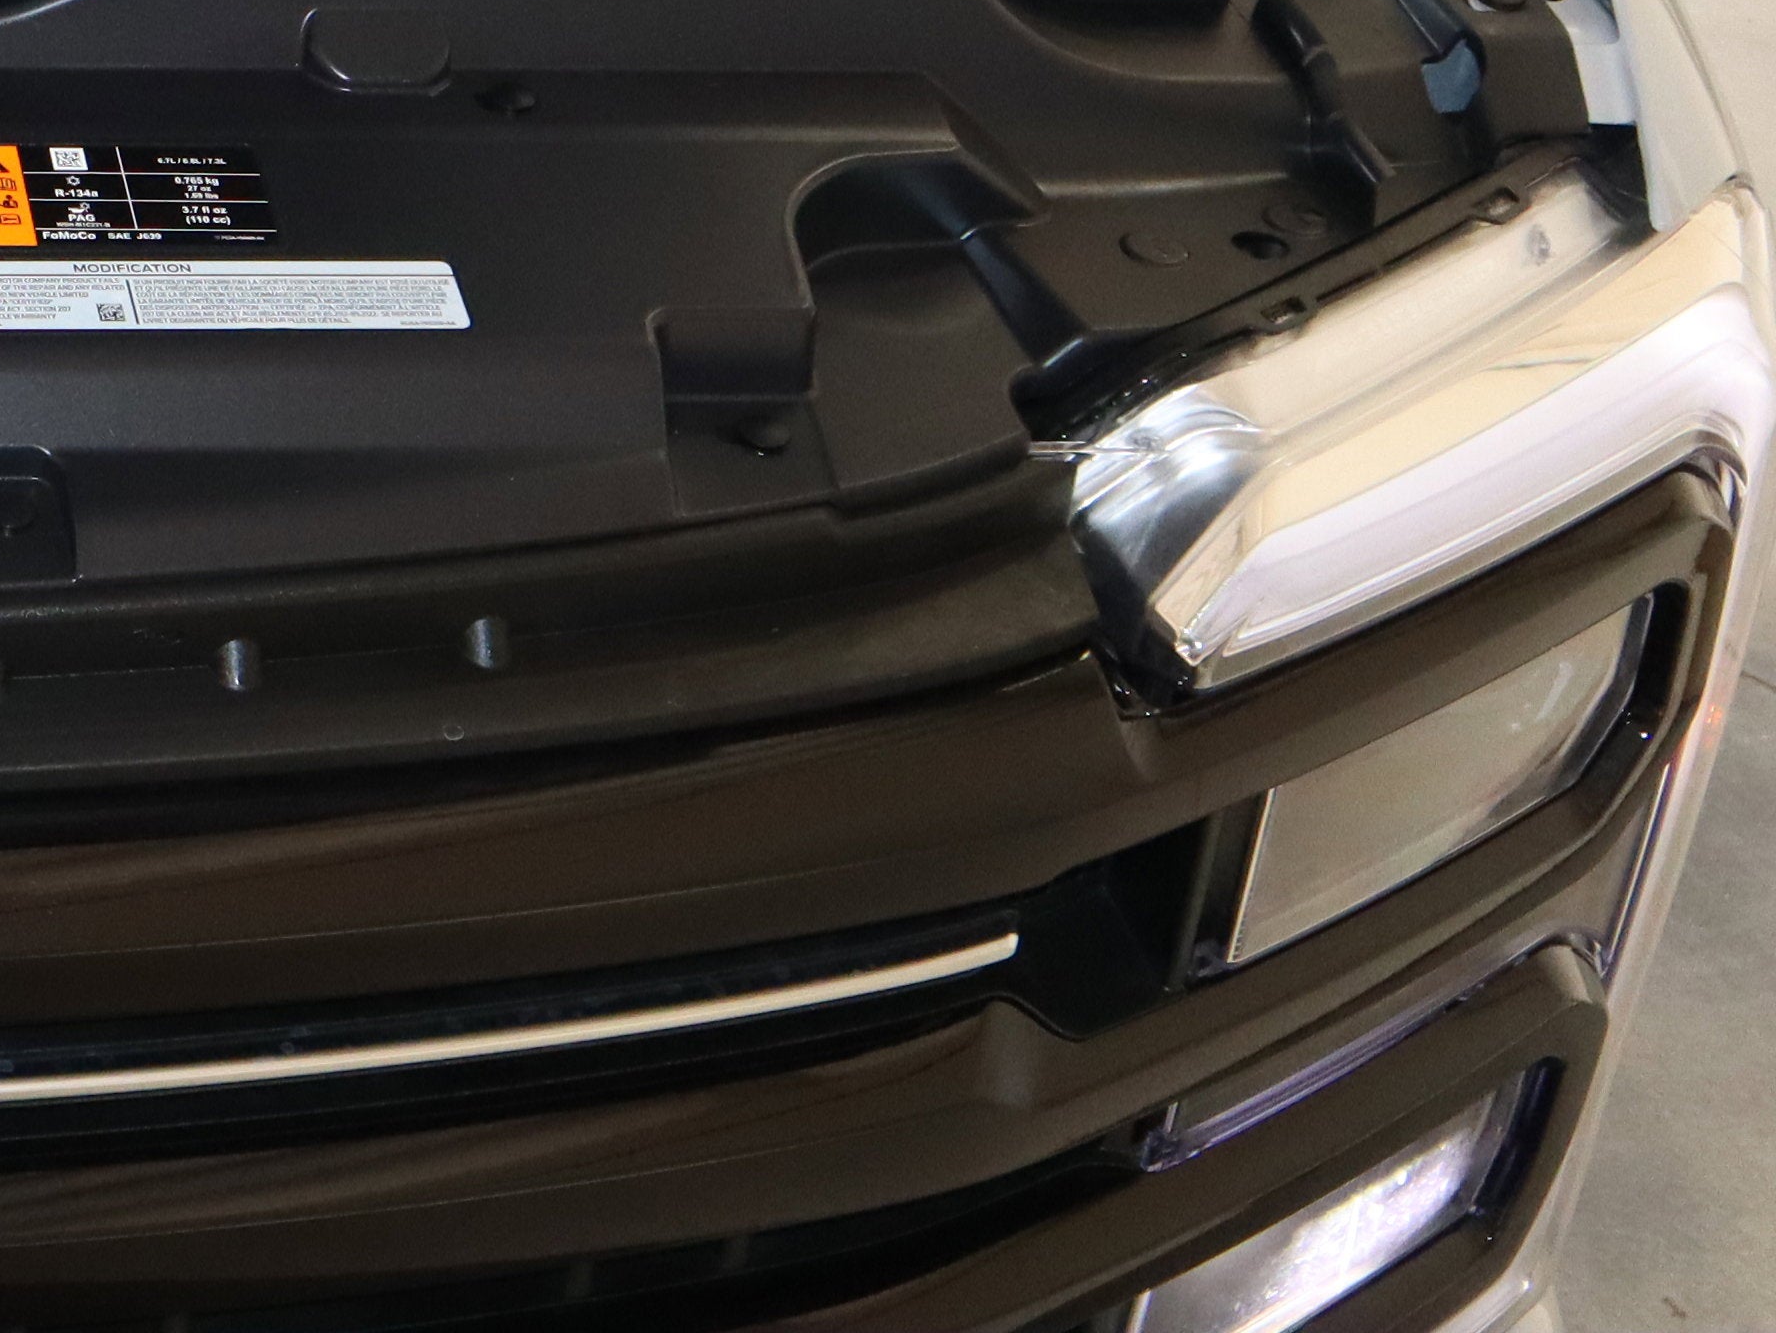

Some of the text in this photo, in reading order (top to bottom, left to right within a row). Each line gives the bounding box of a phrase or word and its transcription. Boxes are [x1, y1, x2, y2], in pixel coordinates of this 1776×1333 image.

[174, 177, 219, 186] 0.765 kg
[54, 189, 99, 197] R-134a
[181, 206, 199, 214] 3.7
[68, 214, 96, 222] PAG
[186, 215, 231, 226] (110 cc)
[42, 231, 97, 240] FoMoCo
[107, 232, 132, 240] SAE
[73, 264, 192, 273] MODIFICATION
